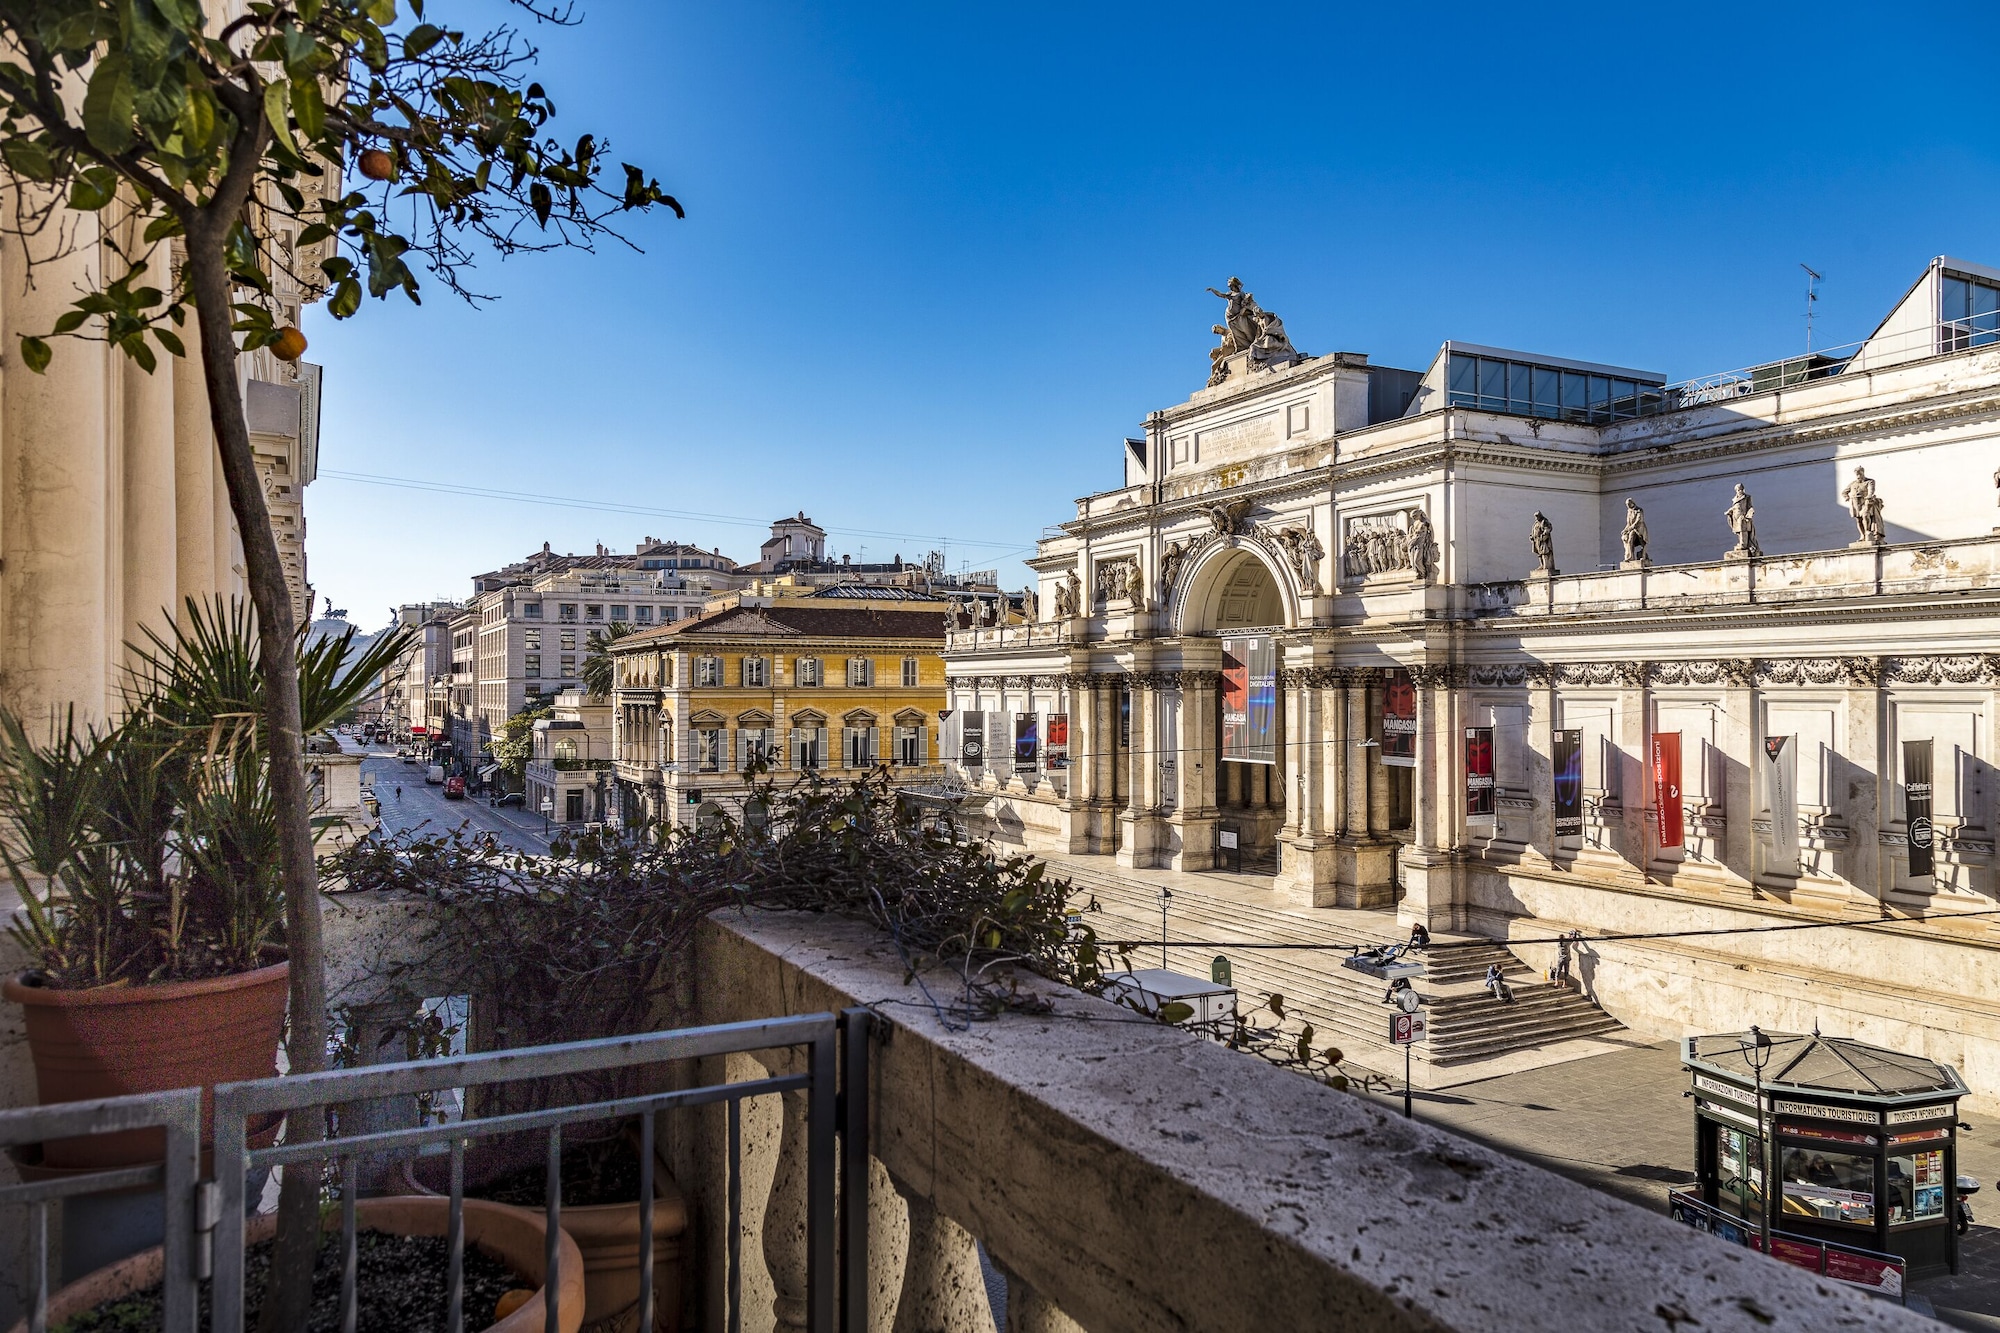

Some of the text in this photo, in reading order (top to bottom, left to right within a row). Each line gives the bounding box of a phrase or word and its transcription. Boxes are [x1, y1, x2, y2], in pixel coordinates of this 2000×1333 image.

[1383, 719, 1417, 731] MANGASIA
[1654, 741, 1663, 790] esposizioni
[1467, 777, 1494, 787] MANGASIA
[1659, 809, 1668, 844] palazzo
[1701, 1077, 1733, 1097] INFORMAZIONI
[1778, 1102, 1877, 1123] INFORMATIONS TOURISTIQUES
[1894, 1106, 1947, 1122] TOURISTEN INFORMATION
